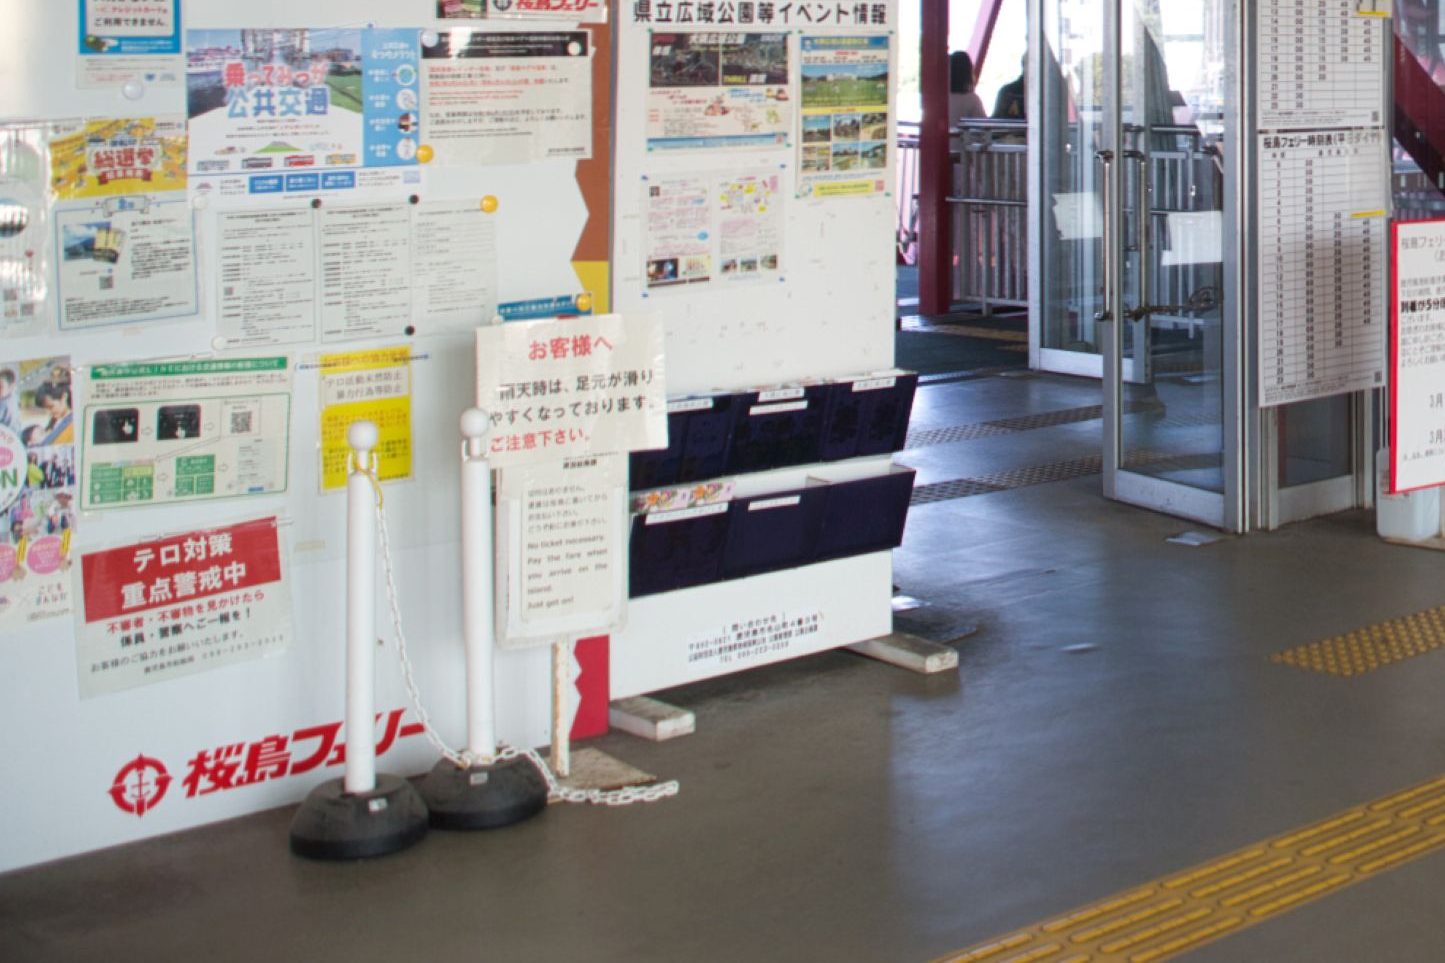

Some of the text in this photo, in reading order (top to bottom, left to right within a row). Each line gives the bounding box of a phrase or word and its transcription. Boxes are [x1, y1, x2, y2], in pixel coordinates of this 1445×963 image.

[225, 86, 330, 119] 公共交通
[527, 333, 614, 361] お客様へ
[489, 395, 655, 427] やすくなっております。
[489, 427, 592, 453] ご注意下さい。
[132, 532, 234, 573] テロ対策
[120, 560, 248, 610] 重点警戒中
[180, 707, 426, 799] 桜島フェリー
